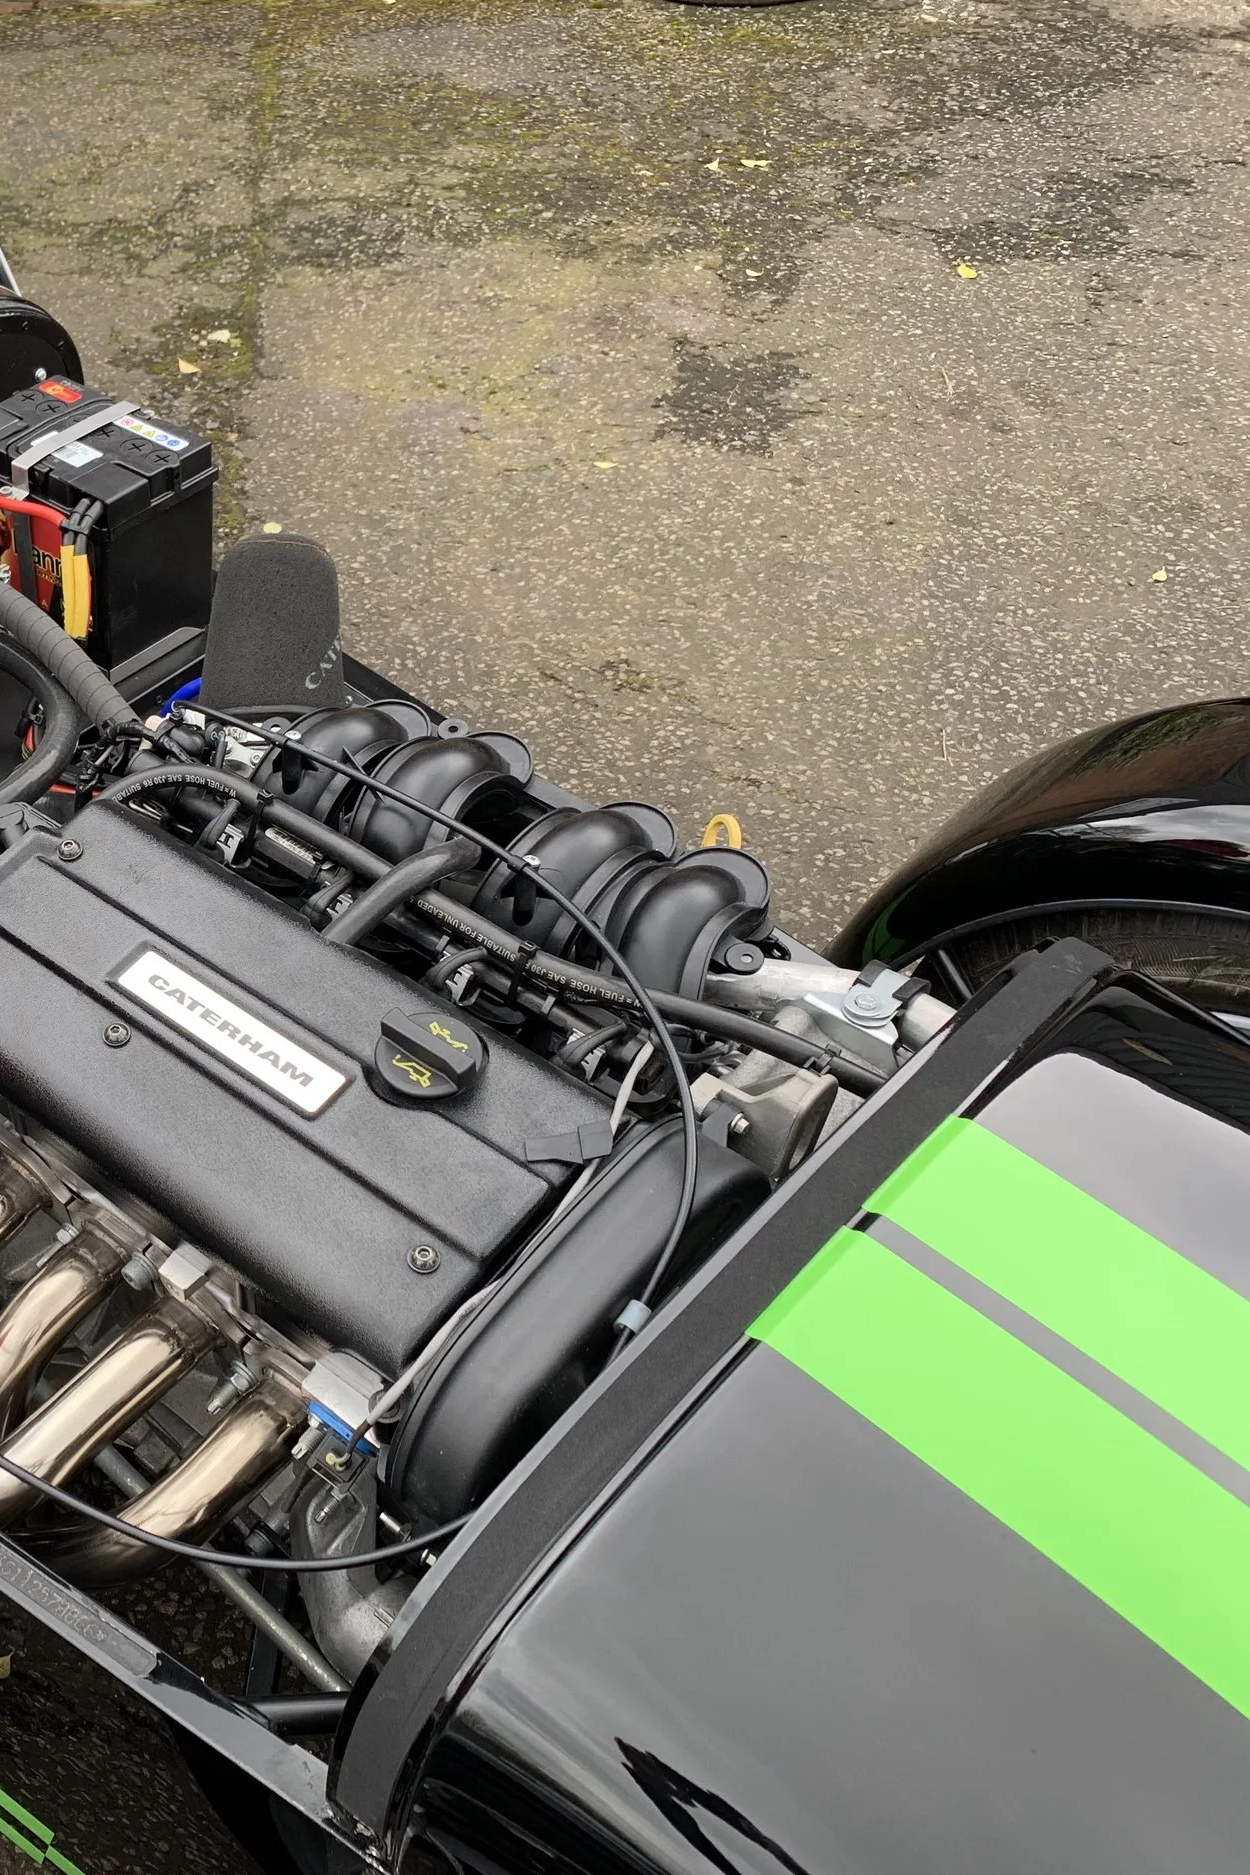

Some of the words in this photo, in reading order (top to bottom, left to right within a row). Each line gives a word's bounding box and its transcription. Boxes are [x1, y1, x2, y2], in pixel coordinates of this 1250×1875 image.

[166, 774, 182, 782] SAE
[185, 774, 205, 785] HOSE
[206, 778, 225, 791] FUEL
[417, 899, 460, 928] UNLEADED
[459, 922, 477, 938] FOR
[476, 933, 517, 962] SUITABLE
[530, 964, 547, 976] J30
[547, 970, 567, 985] SAE
[570, 978, 597, 995] HOSE
[599, 988, 625, 1003] FUEL
[147, 974, 314, 1088] CATERHAM
